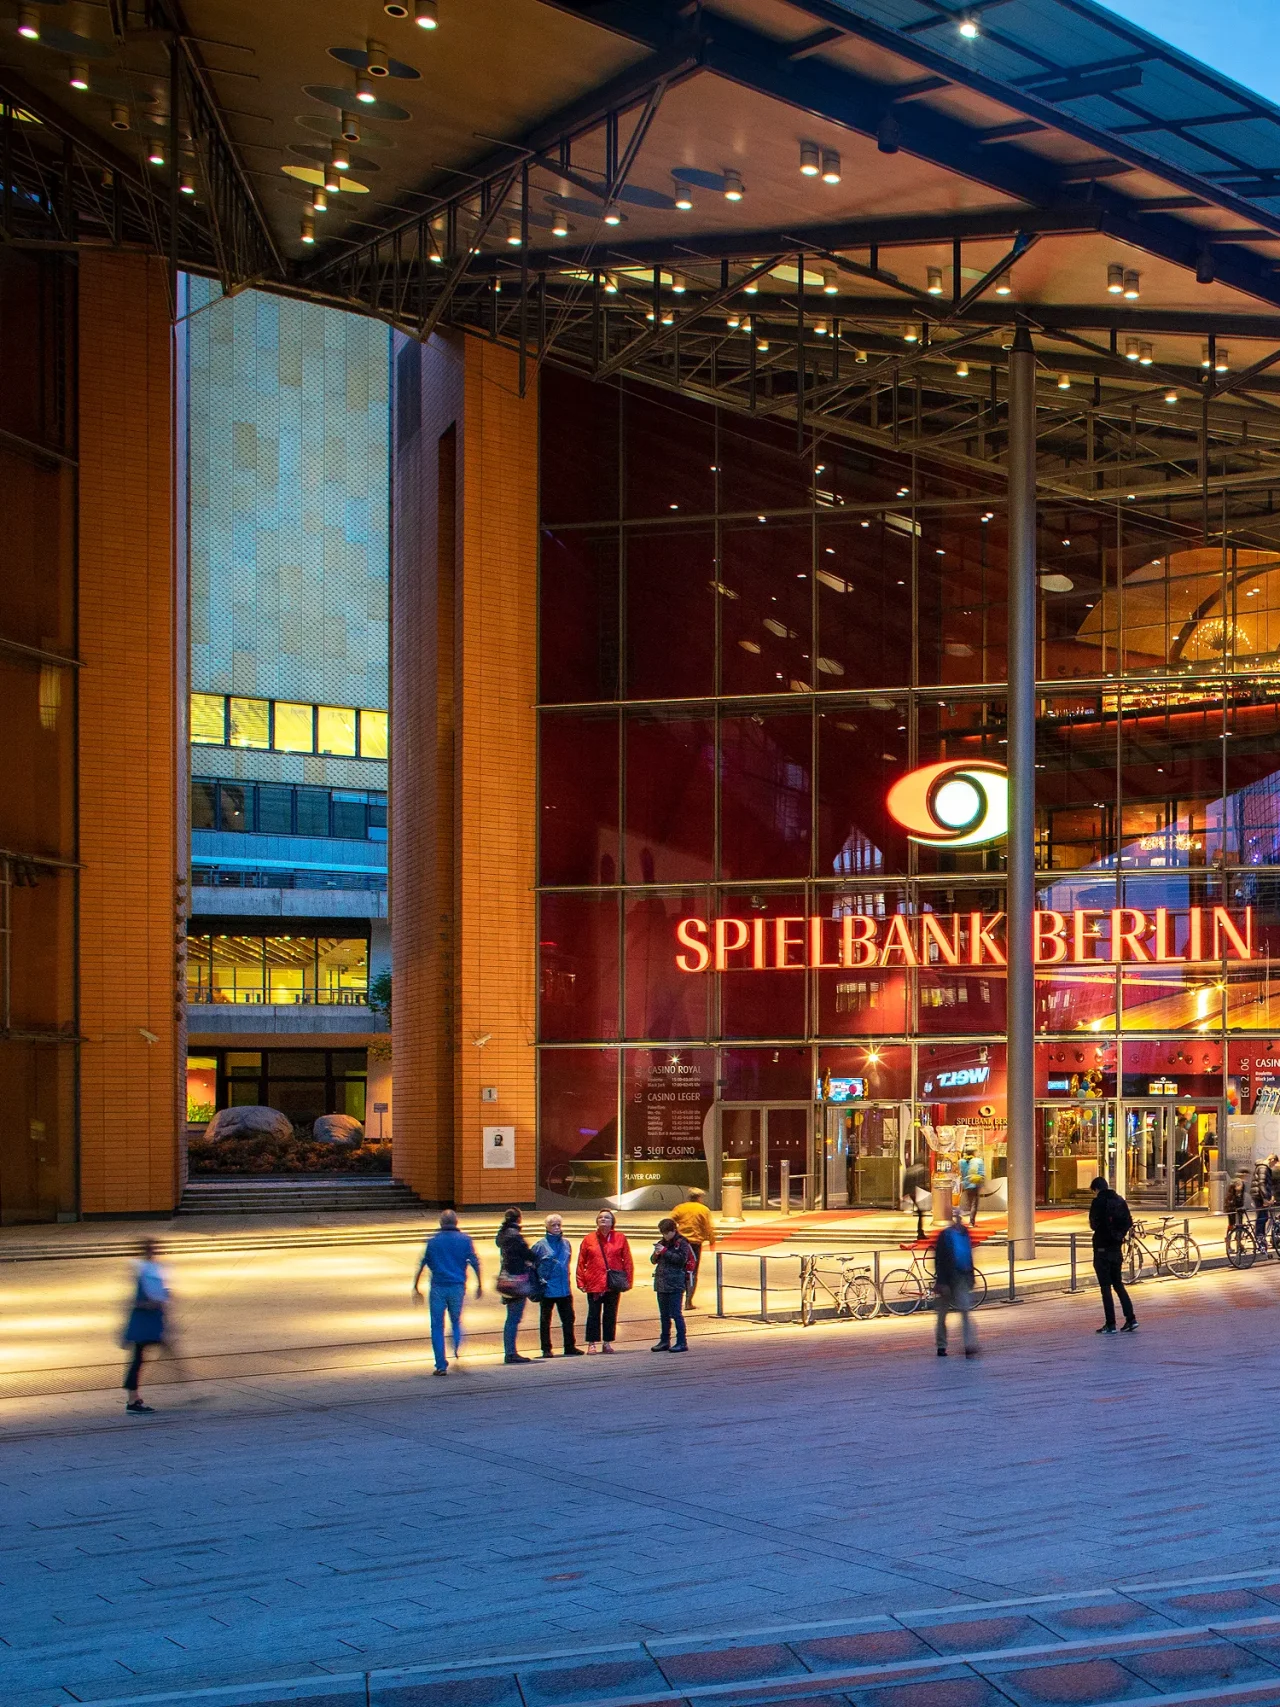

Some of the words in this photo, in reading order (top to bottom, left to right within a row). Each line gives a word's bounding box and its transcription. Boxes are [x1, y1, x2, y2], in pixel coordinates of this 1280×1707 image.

[675, 911, 1007, 973] SPIELBANK
[1033, 905, 1252, 965] BERLIN
[647, 1065, 676, 1074] CASINO
[677, 1065, 702, 1074] ROYAL
[1241, 1058, 1250, 1071] OG
[647, 1092, 676, 1102] CASINO
[677, 1092, 701, 1101] LEGER
[1241, 1087, 1250, 1098] EG
[956, 1117, 992, 1125] SPIELBANK
[634, 1146, 643, 1158] UG
[646, 1146, 665, 1155] SLOT
[666, 1146, 696, 1155] CASINO
